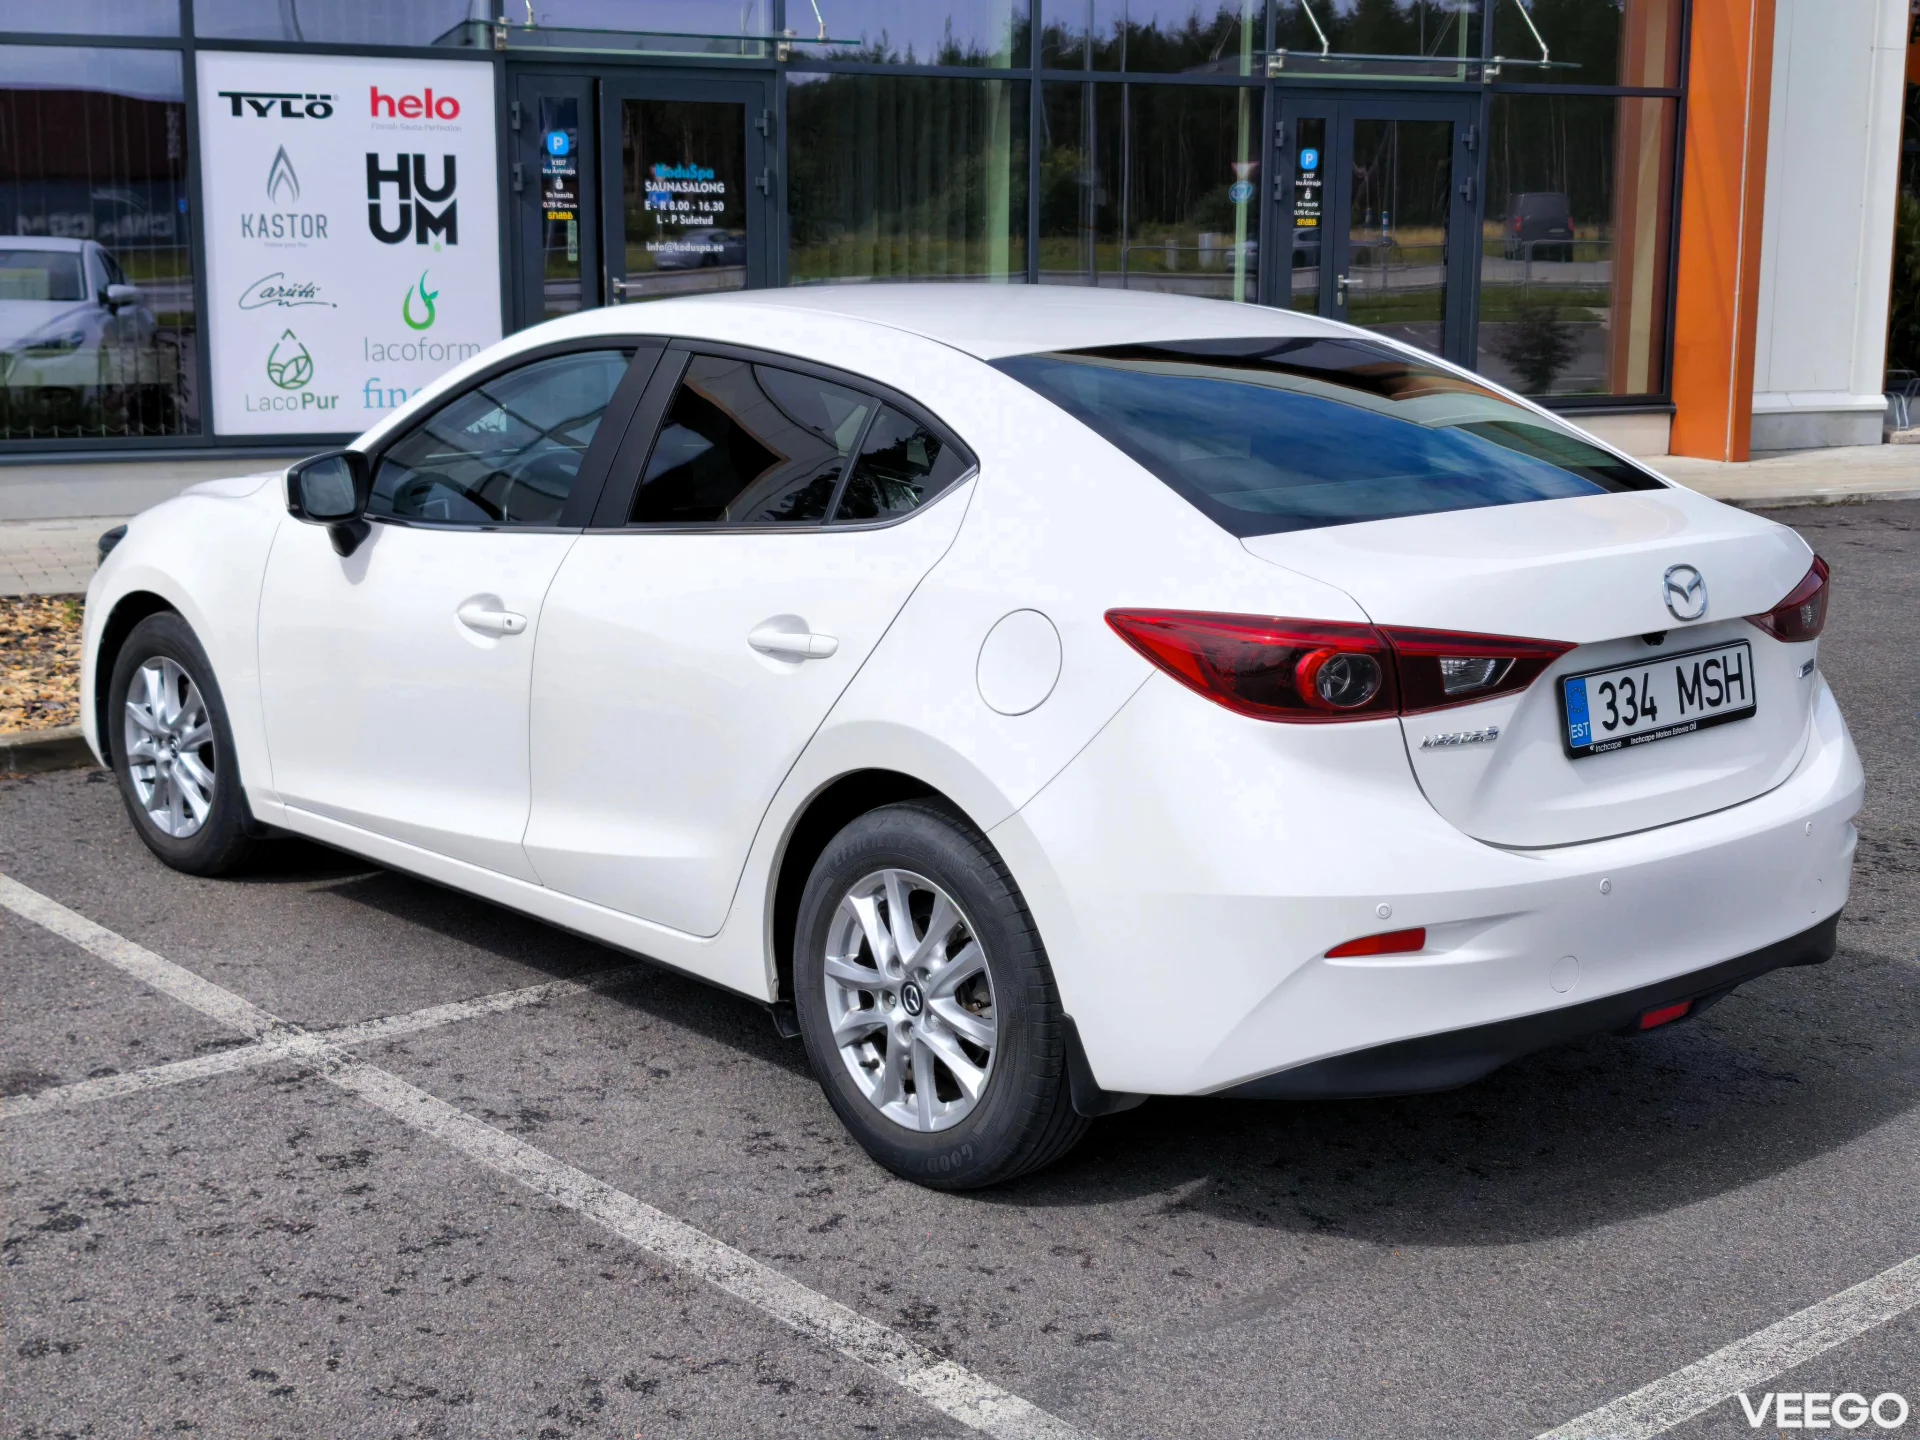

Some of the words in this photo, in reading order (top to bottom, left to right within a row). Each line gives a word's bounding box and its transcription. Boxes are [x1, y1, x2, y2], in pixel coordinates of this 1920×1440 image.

[218, 91, 333, 119] TYLÖ
[370, 86, 460, 120] helo
[655, 163, 715, 182] KoduSpa
[645, 181, 725, 193] SAUNASALONG
[645, 201, 651, 210] E
[661, 201, 667, 210] R
[670, 202, 690, 211] 8.00
[699, 202, 725, 212] 16.30
[241, 214, 328, 238] KASTOR
[657, 215, 662, 224] L
[672, 215, 677, 224] P
[680, 215, 713, 225] Suletud
[646, 242, 724, 253] info@koduspa.ee
[364, 336, 480, 361] lacoform
[1598, 672, 1658, 731] 334
[1675, 652, 1746, 715] MSH
[1570, 721, 1590, 739] EST
[1595, 741, 1622, 753] Inchcape
[1630, 734, 1655, 745] Inchcape
[1655, 730, 1672, 739] Motors
[1672, 725, 1689, 735] Estonia
